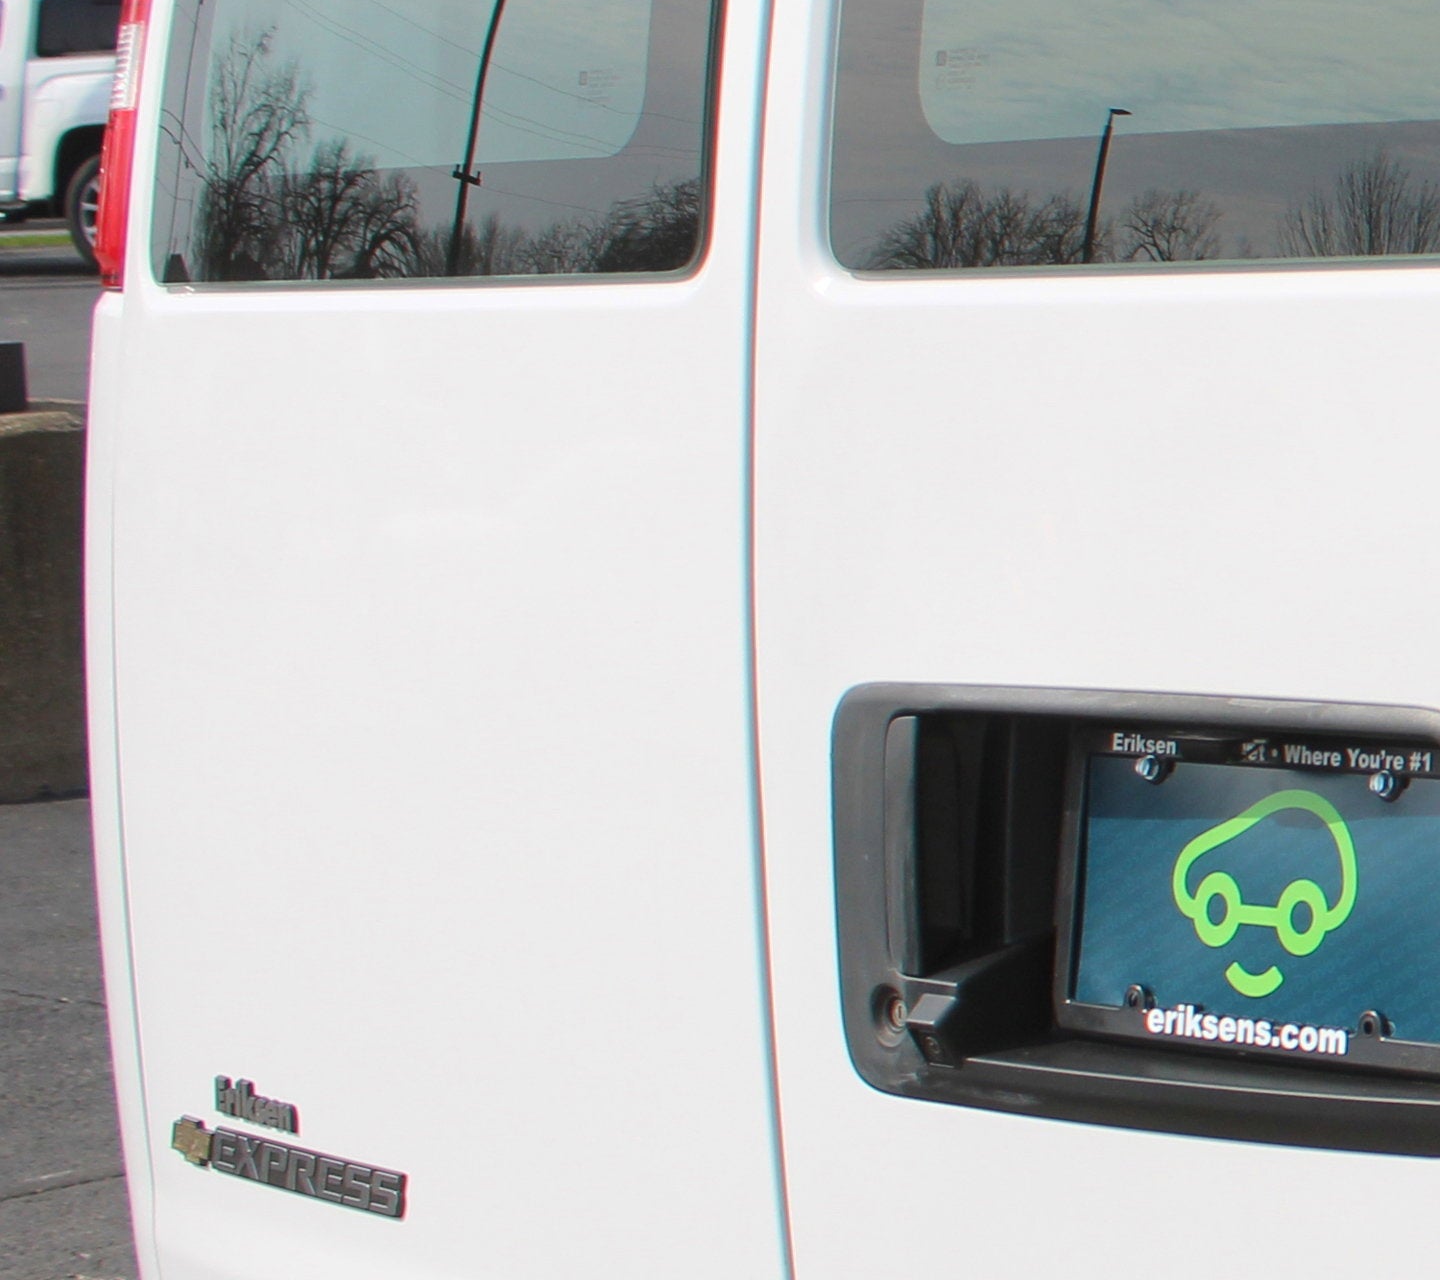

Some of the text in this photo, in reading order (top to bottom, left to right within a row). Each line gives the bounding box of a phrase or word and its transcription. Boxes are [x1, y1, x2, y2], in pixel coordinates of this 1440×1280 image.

[1112, 732, 1177, 755] Eriksen
[1284, 744, 1342, 767] Where
[1346, 748, 1404, 770] You're
[1409, 751, 1432, 771] #1
[1146, 1004, 1348, 1055] eriksens.com
[215, 1075, 299, 1134] Eriksen
[212, 1127, 405, 1219] EXPRESS
